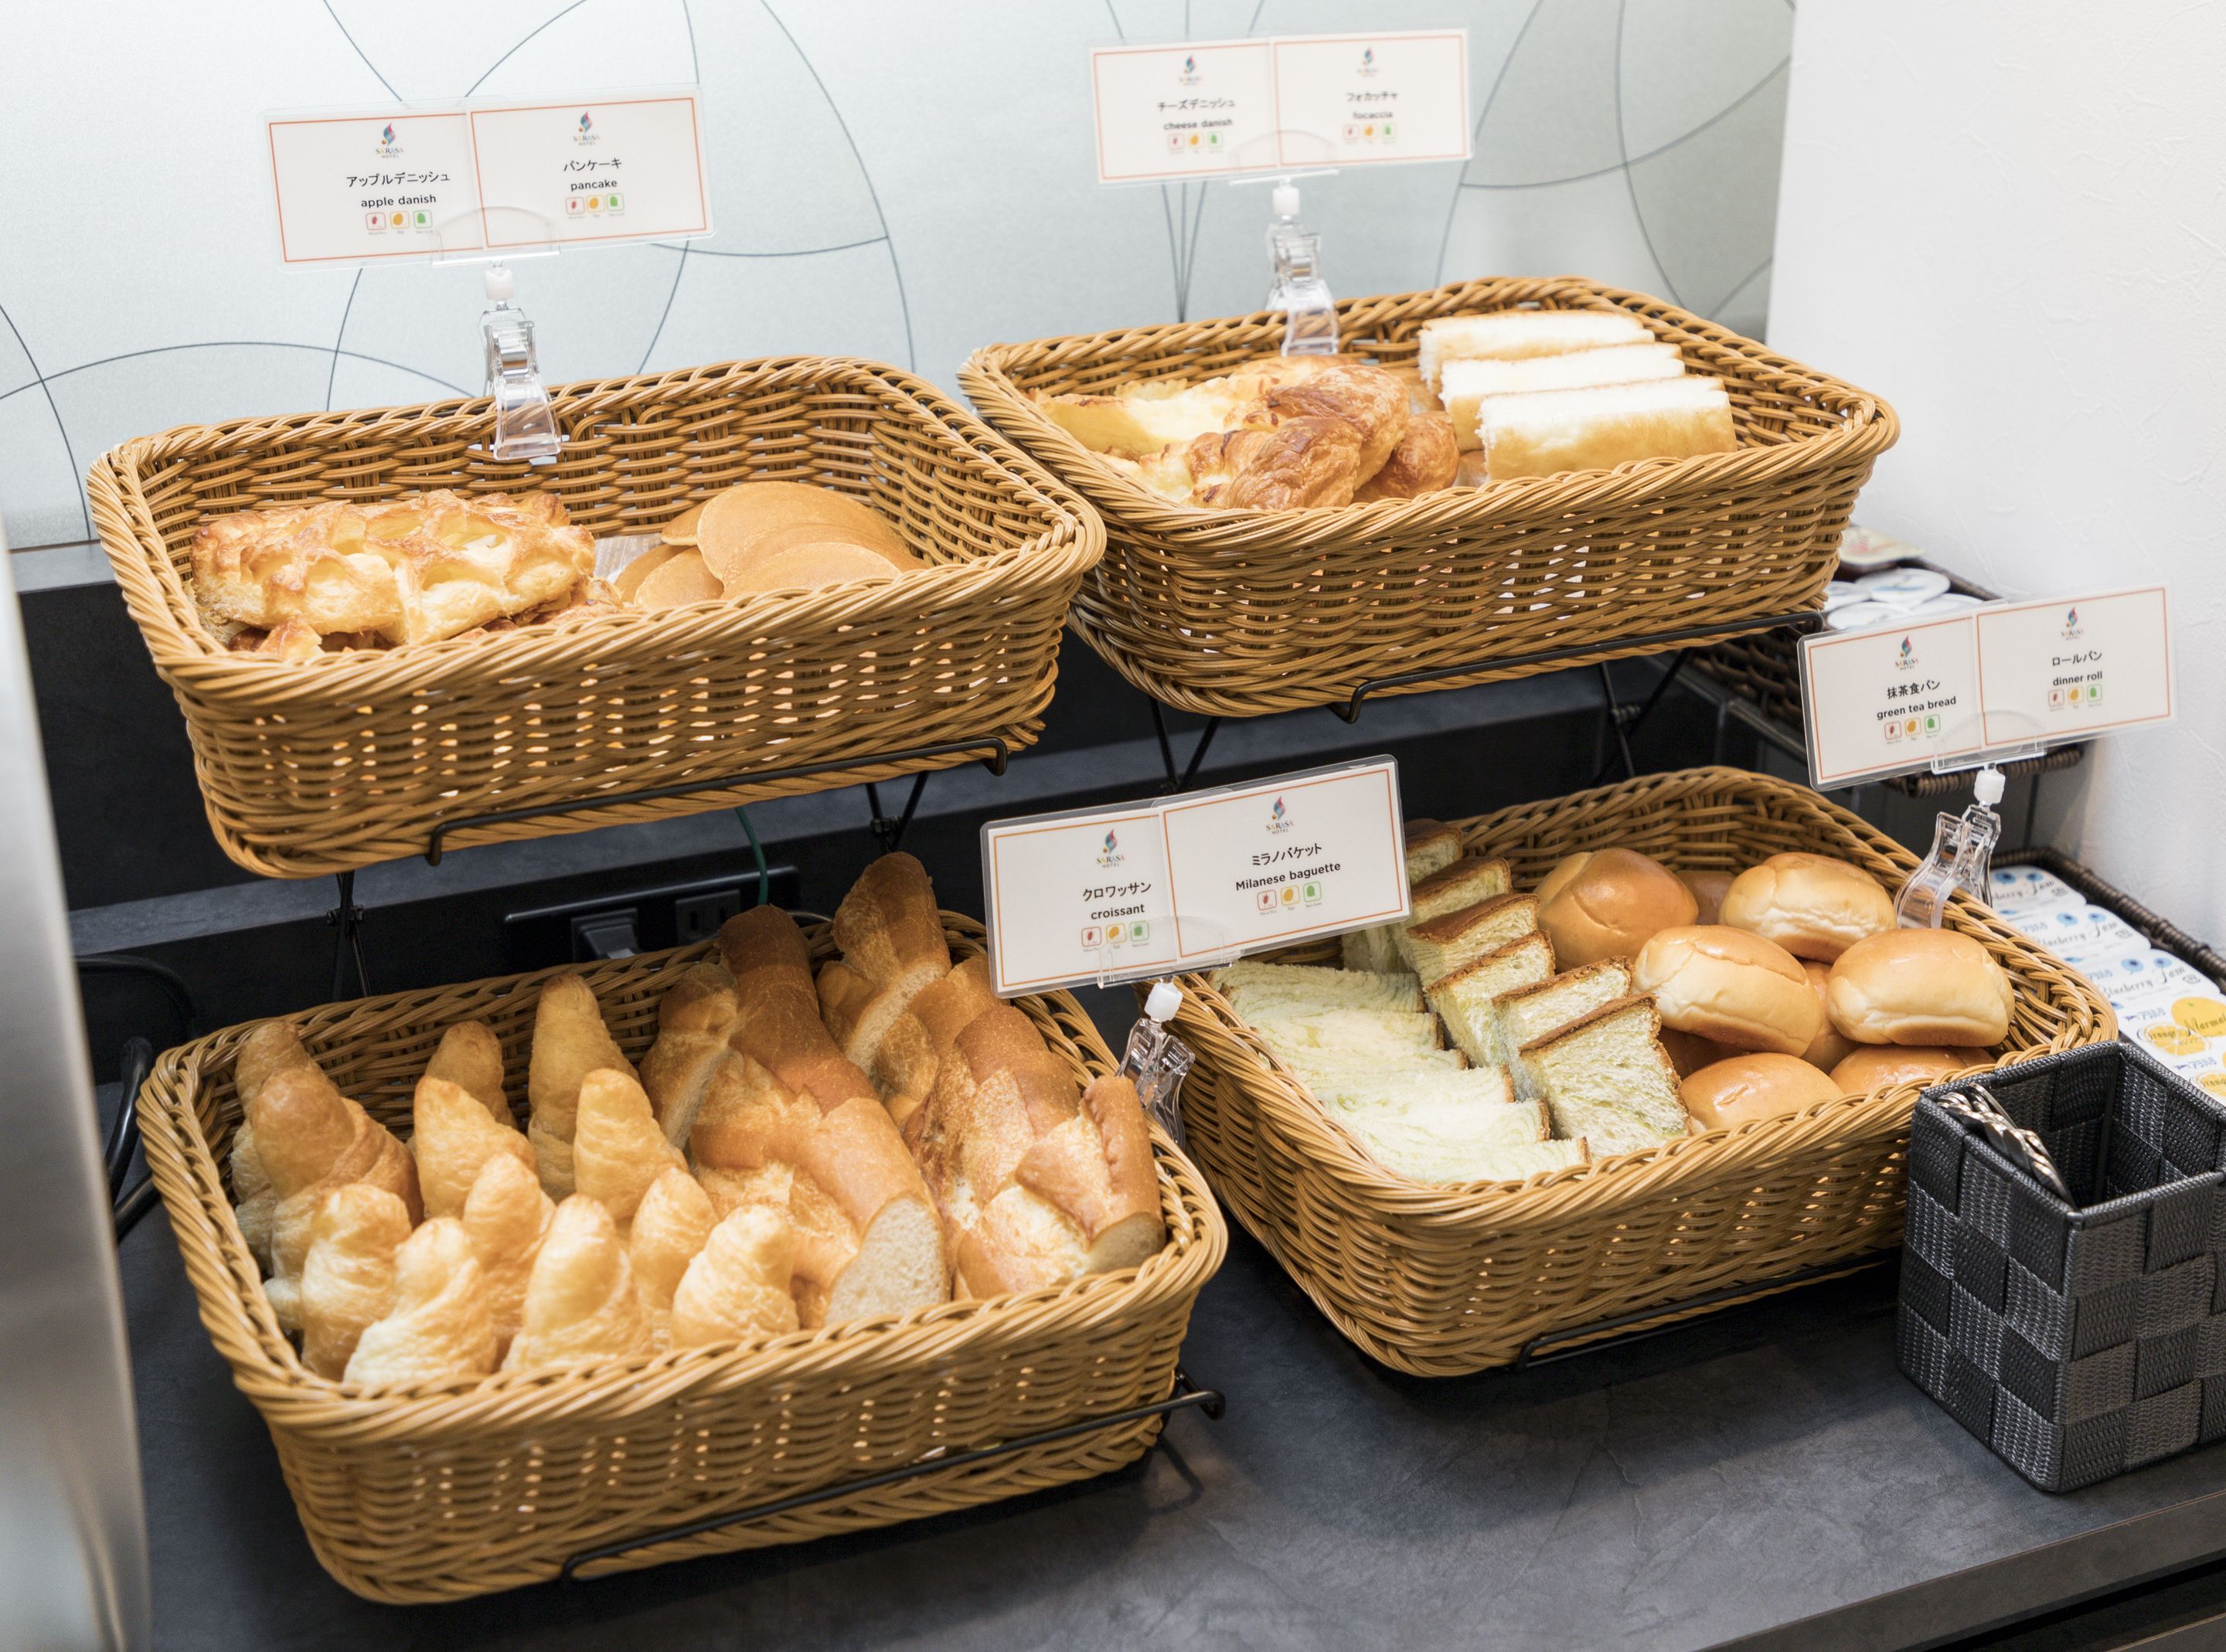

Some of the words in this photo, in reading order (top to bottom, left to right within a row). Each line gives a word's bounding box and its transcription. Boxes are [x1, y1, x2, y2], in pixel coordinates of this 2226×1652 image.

[1201, 118, 1233, 127] danish
[563, 158, 621, 172] パンケーキ
[346, 171, 450, 187] アップルデニッシュ
[570, 179, 618, 192] pancake
[361, 197, 394, 208] apple
[398, 194, 437, 206] danish
[2052, 650, 2102, 666] ロールパン
[2053, 675, 2084, 686] dinner
[2087, 671, 2102, 681] roll
[1887, 679, 1940, 699] 抹茶食パン
[1877, 707, 1906, 721] green
[1908, 702, 1925, 713] tea
[1928, 695, 1957, 709] bread
[1266, 820, 1294, 831] SARASA
[1096, 854, 1125, 864] SARASA
[1236, 873, 1285, 891] Milanese
[1289, 862, 1341, 880] baguette
[1082, 882, 1152, 902] クロワッサン
[1091, 903, 1145, 919] croissant
